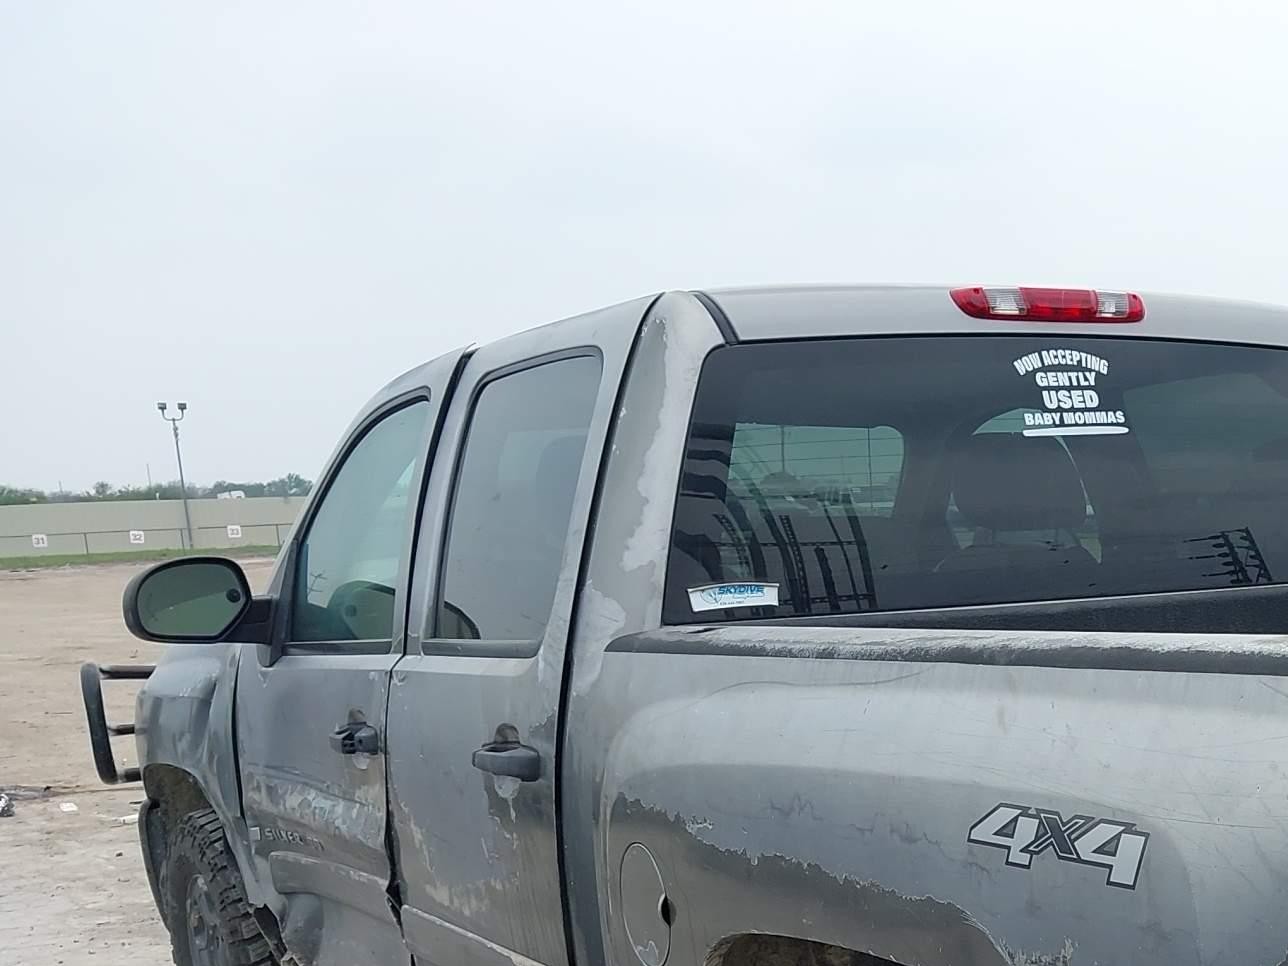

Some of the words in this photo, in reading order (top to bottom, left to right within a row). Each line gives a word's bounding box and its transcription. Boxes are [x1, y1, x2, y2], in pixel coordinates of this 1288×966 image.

[1012, 350, 1042, 376] NOW
[1041, 349, 1109, 375] ACCEPTING
[1035, 371, 1096, 387] GENTLY
[1042, 389, 1099, 409] USED
[1023, 412, 1061, 426] BABY
[1063, 410, 1126, 425] MOMMAS
[718, 584, 765, 595] SKYDIVE
